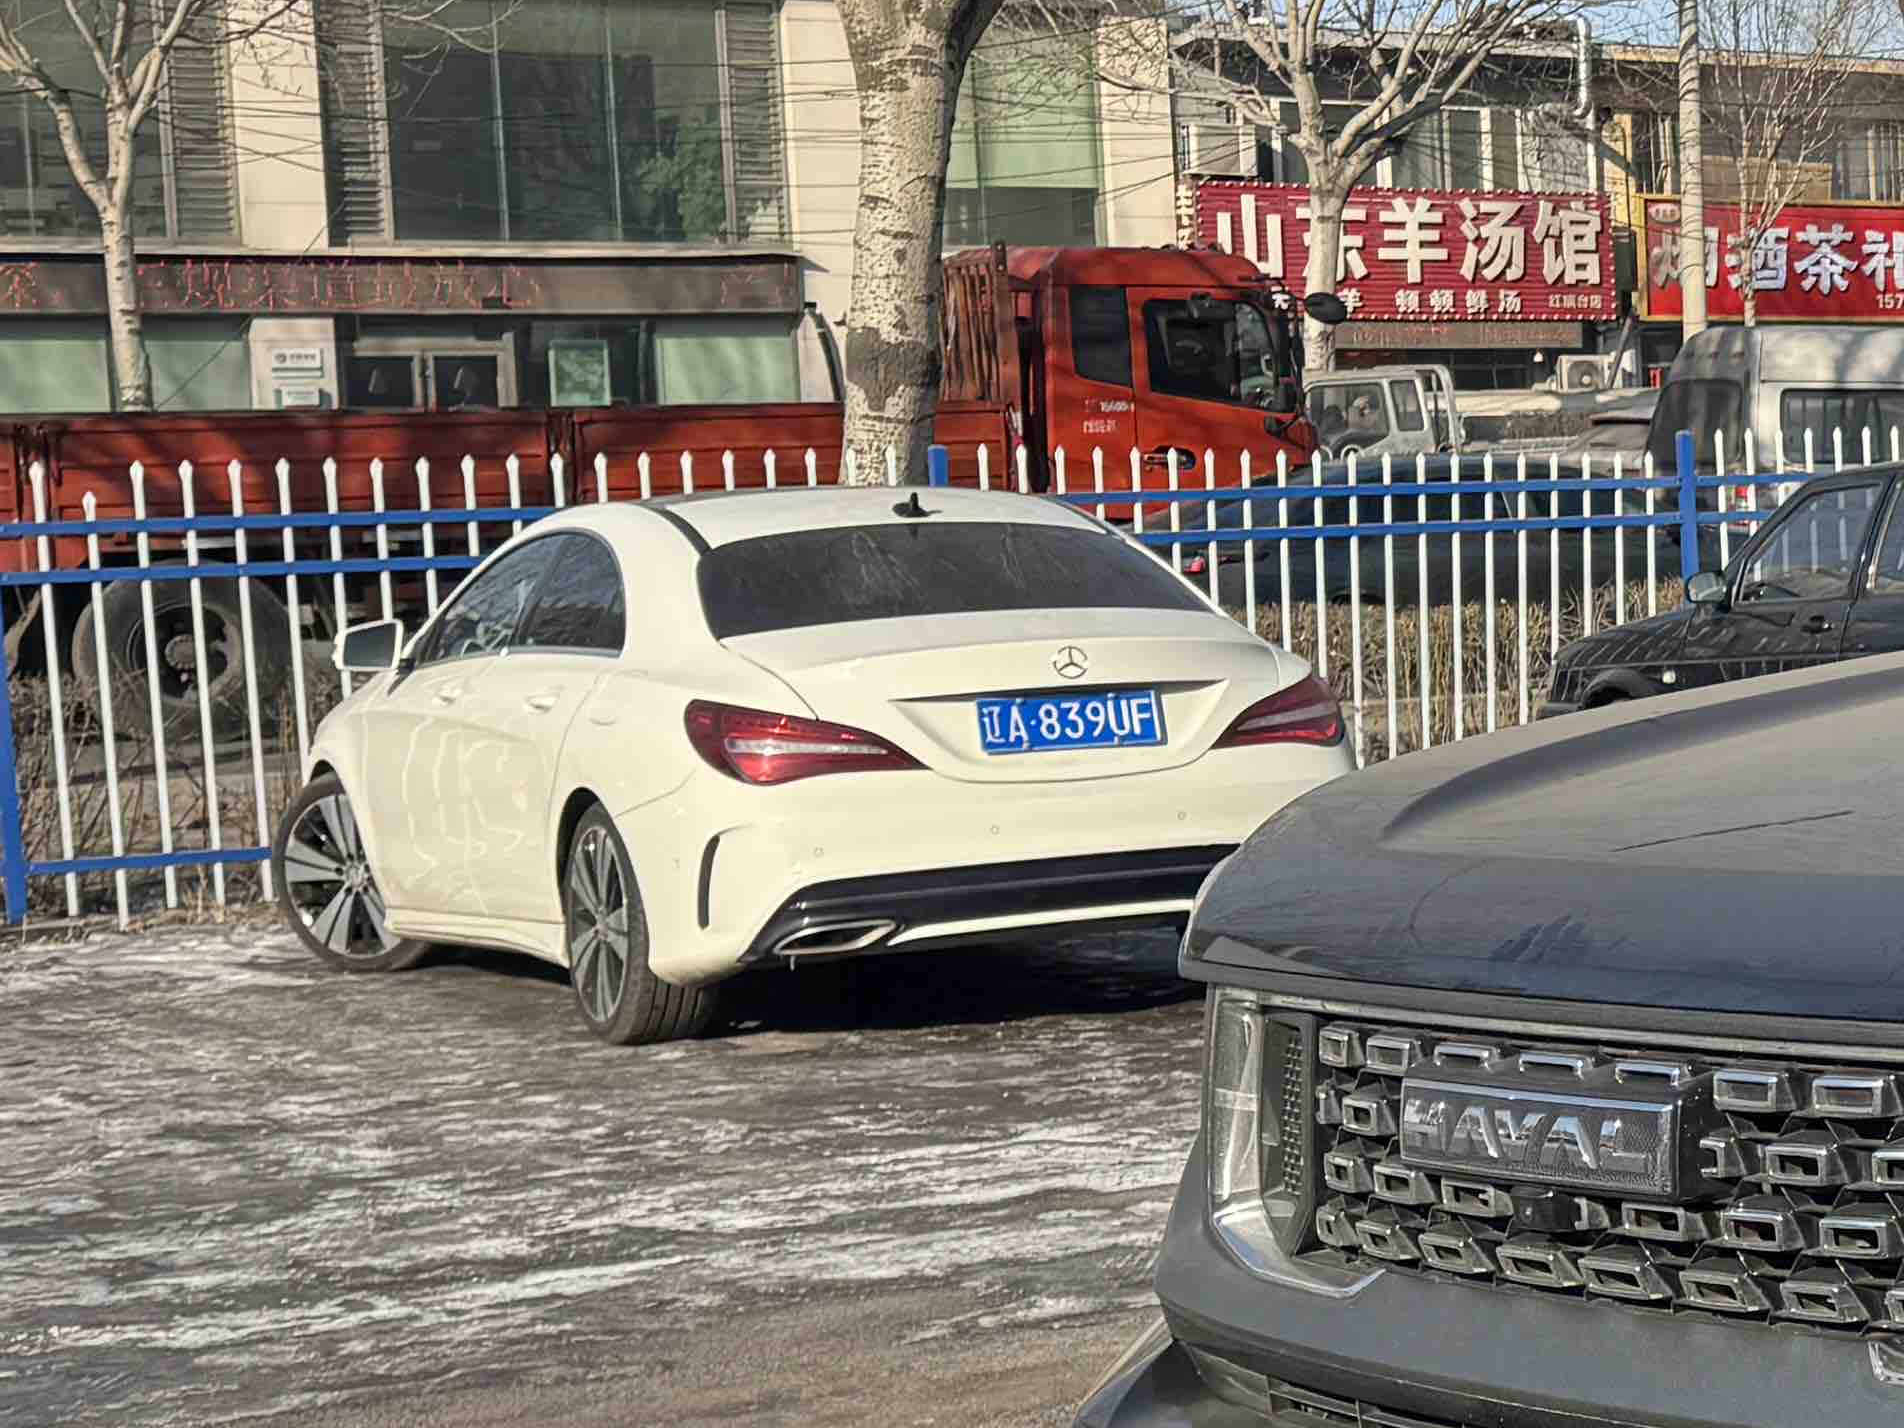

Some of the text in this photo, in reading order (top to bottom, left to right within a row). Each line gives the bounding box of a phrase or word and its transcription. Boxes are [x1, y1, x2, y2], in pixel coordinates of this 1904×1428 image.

[1217, 194, 1601, 285] 山东羊汤馆
[1395, 289, 1522, 314] 顿顿鲜汤
[1404, 1098, 1649, 1172] HAVAL
